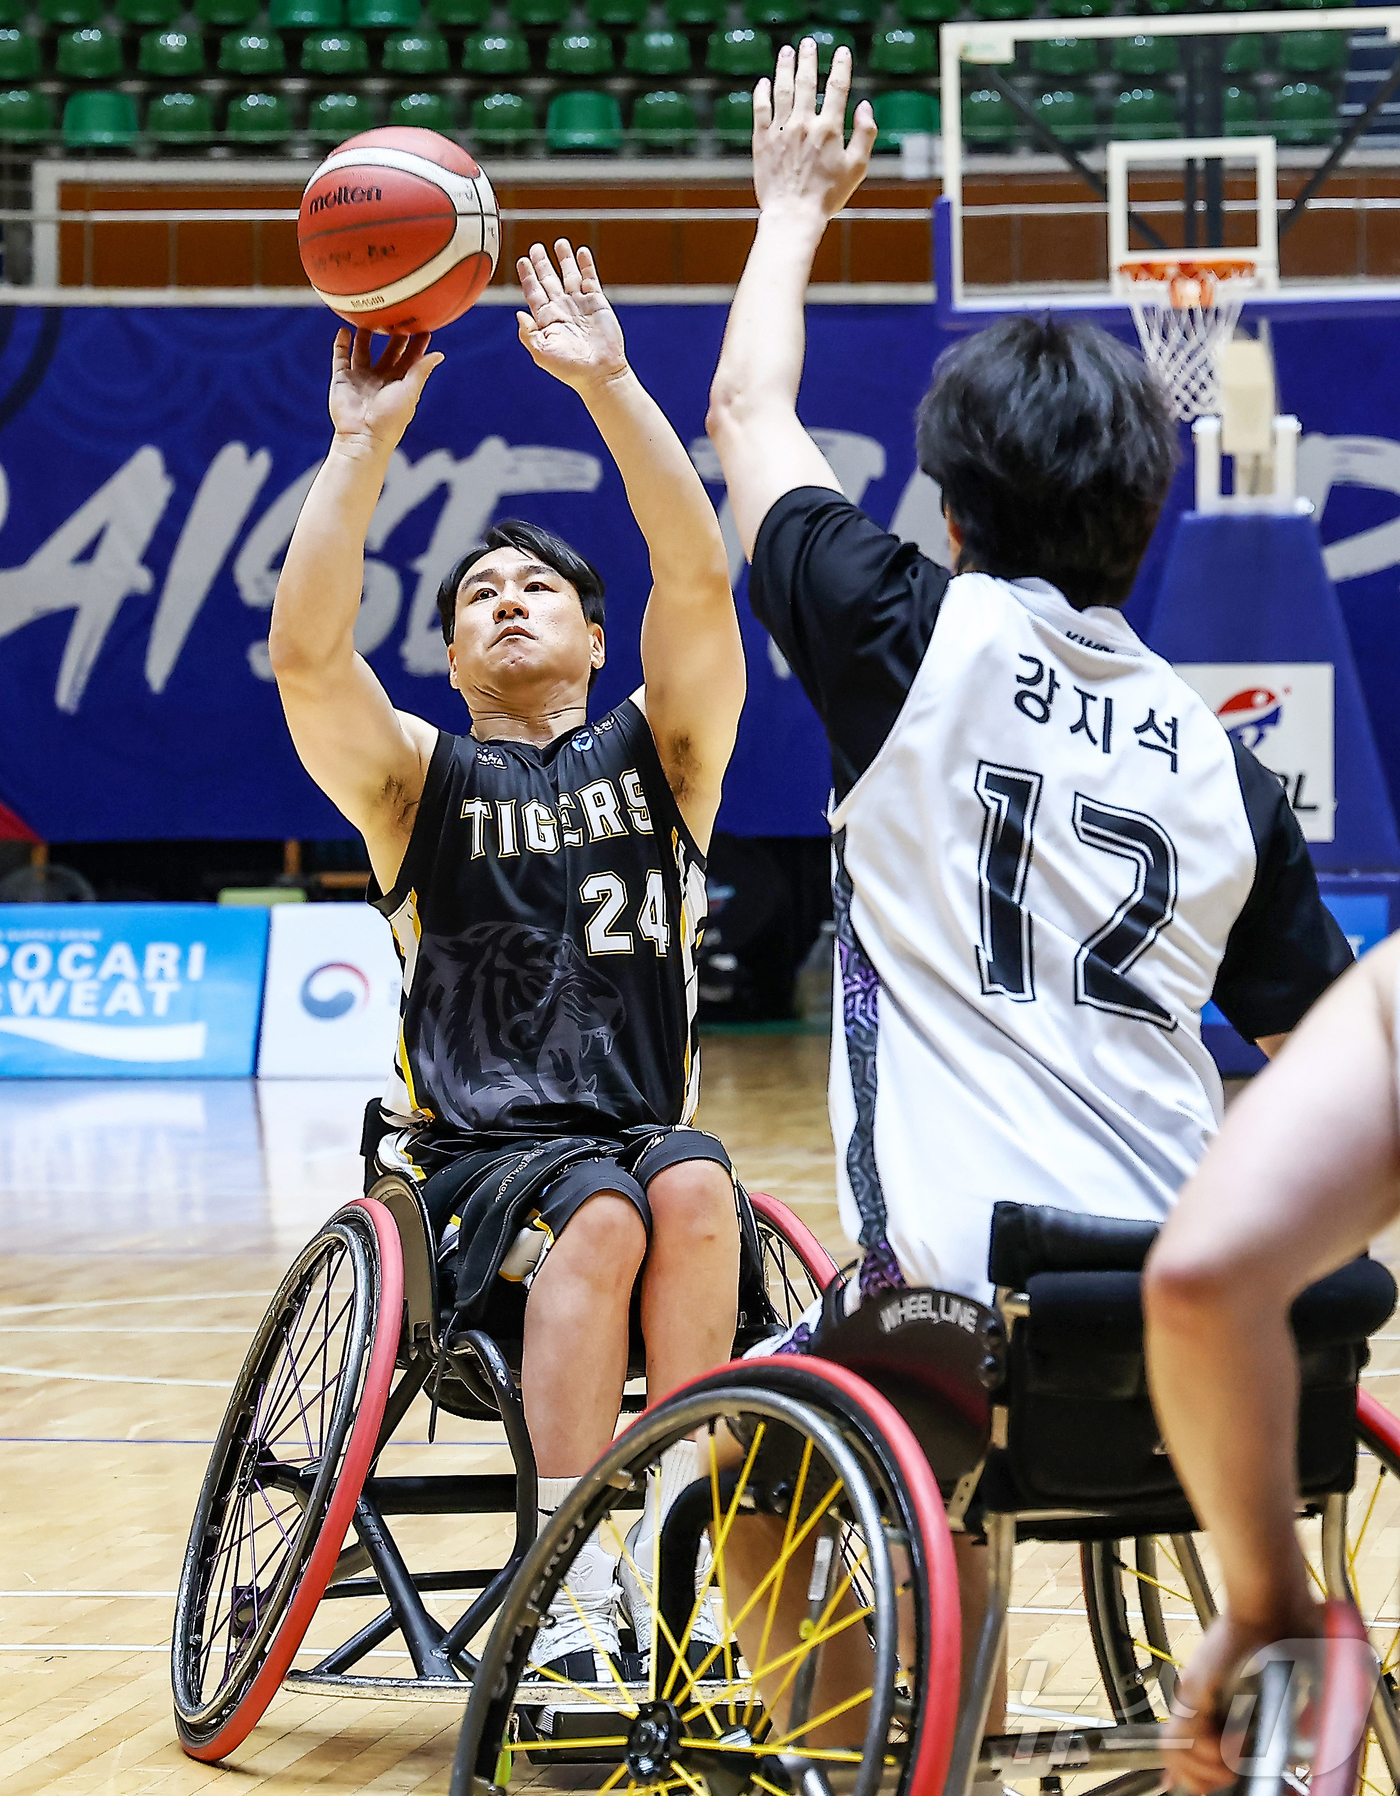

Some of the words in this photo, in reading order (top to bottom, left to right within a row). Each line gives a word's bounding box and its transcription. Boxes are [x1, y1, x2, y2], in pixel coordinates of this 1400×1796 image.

[309, 186, 382, 215] molten
[1014, 653, 1178, 774] 강지석
[460, 767, 655, 861] TIGERS
[578, 868, 671, 958] 24
[974, 759, 1178, 1035] 12
[0, 941, 207, 983] OCARI
[0, 980, 182, 1018] WEAT
